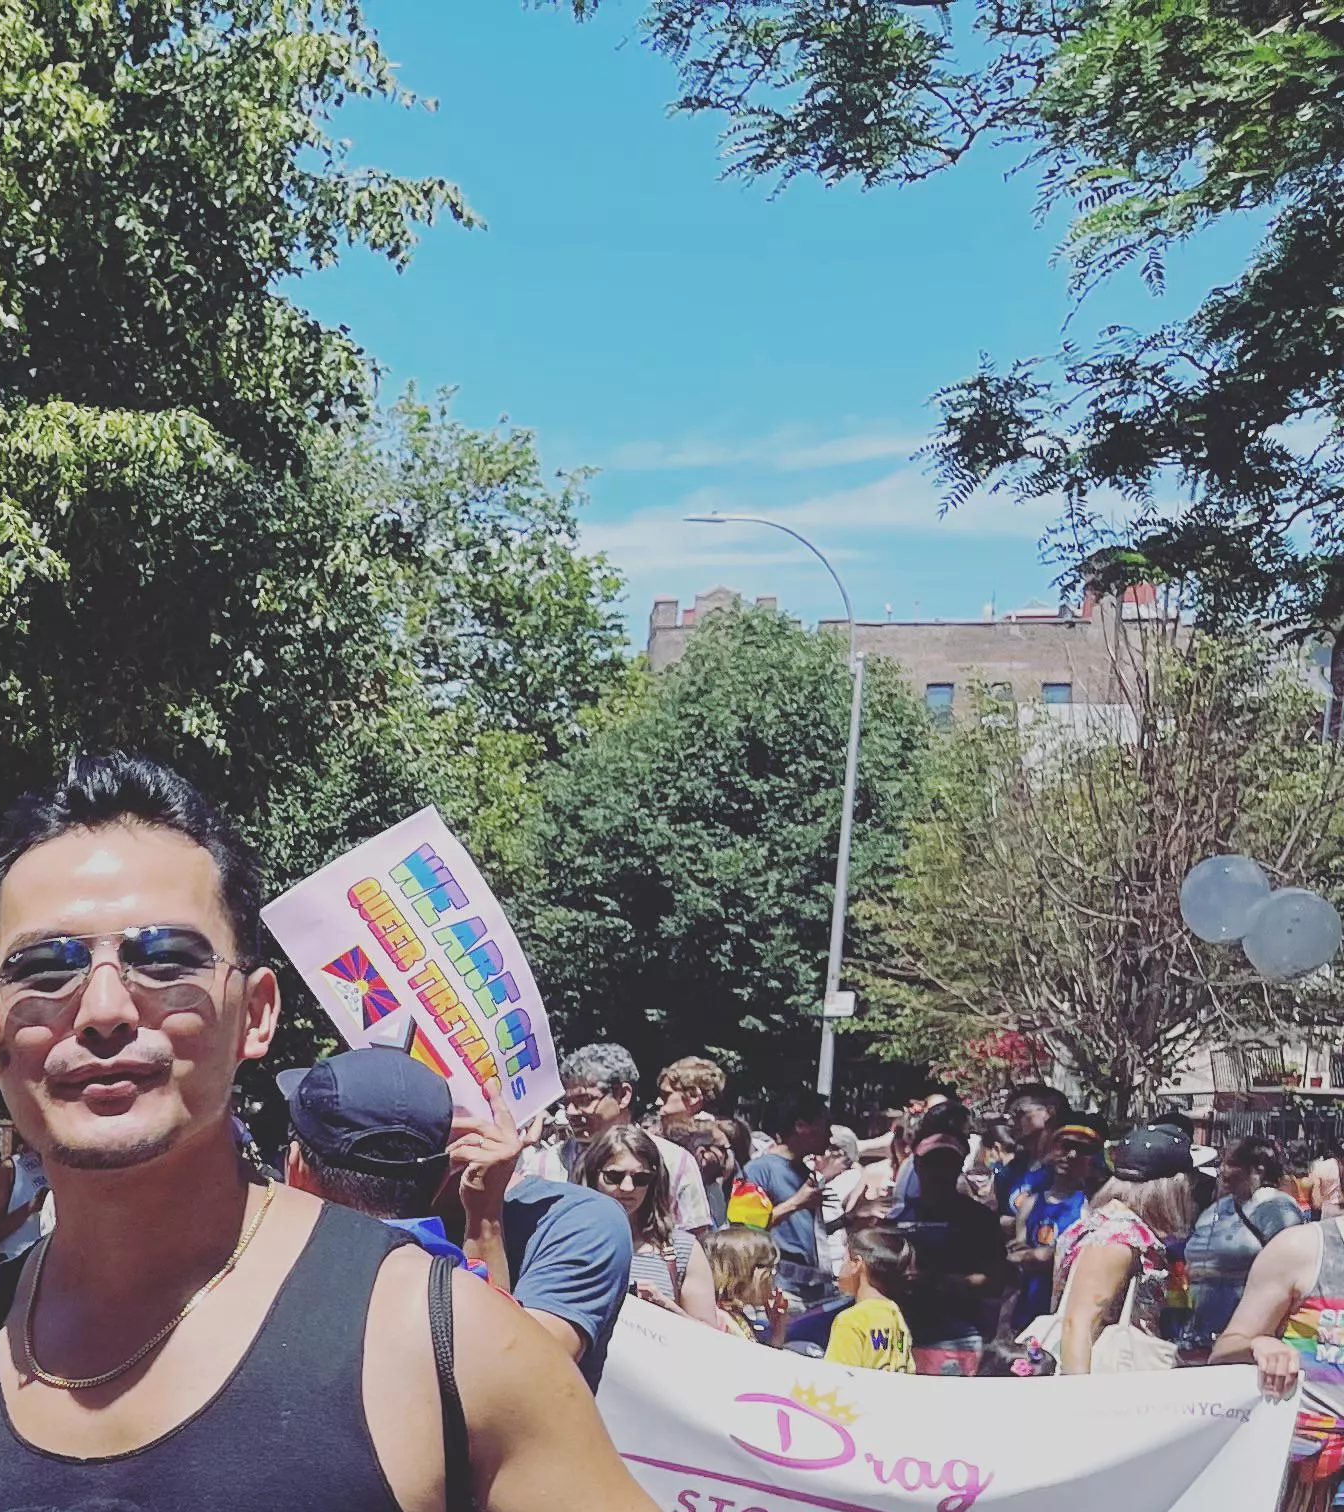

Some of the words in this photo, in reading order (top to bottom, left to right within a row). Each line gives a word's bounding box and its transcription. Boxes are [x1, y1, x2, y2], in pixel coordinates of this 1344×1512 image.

[347, 876, 427, 973] QUEER
[387, 842, 470, 928] WE
[431, 915, 521, 1020] ARE
